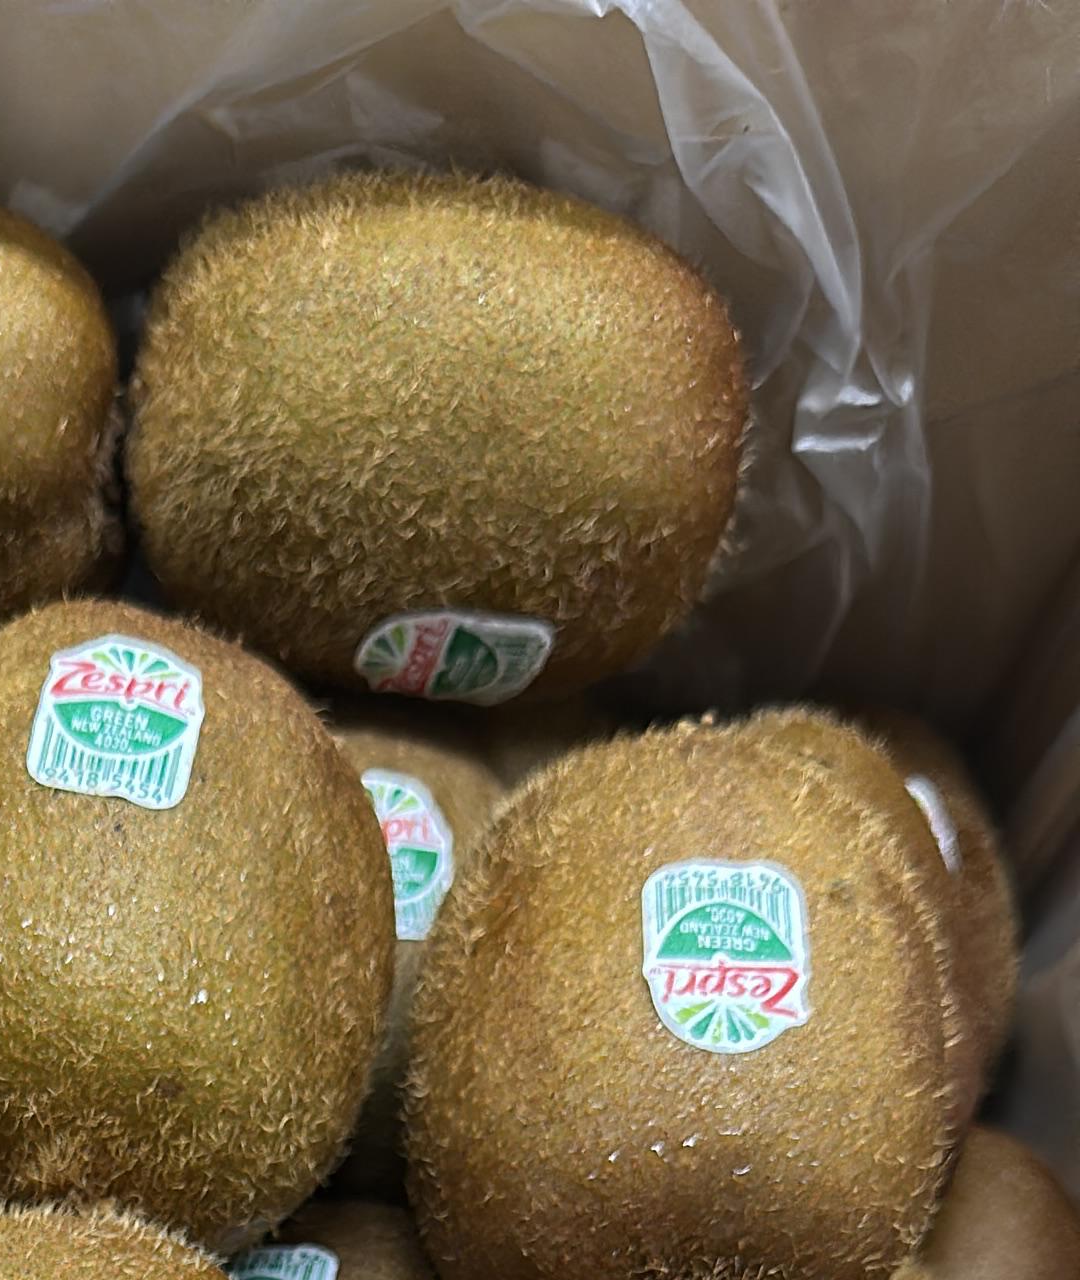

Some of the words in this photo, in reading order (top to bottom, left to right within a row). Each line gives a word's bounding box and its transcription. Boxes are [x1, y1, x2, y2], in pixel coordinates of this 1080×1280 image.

[51, 660, 189, 709] Zespri
[90, 706, 150, 733] GREEN
[45, 766, 98, 789] 9418
[110, 774, 161, 805] 5454
[661, 961, 799, 1018] Zespri
